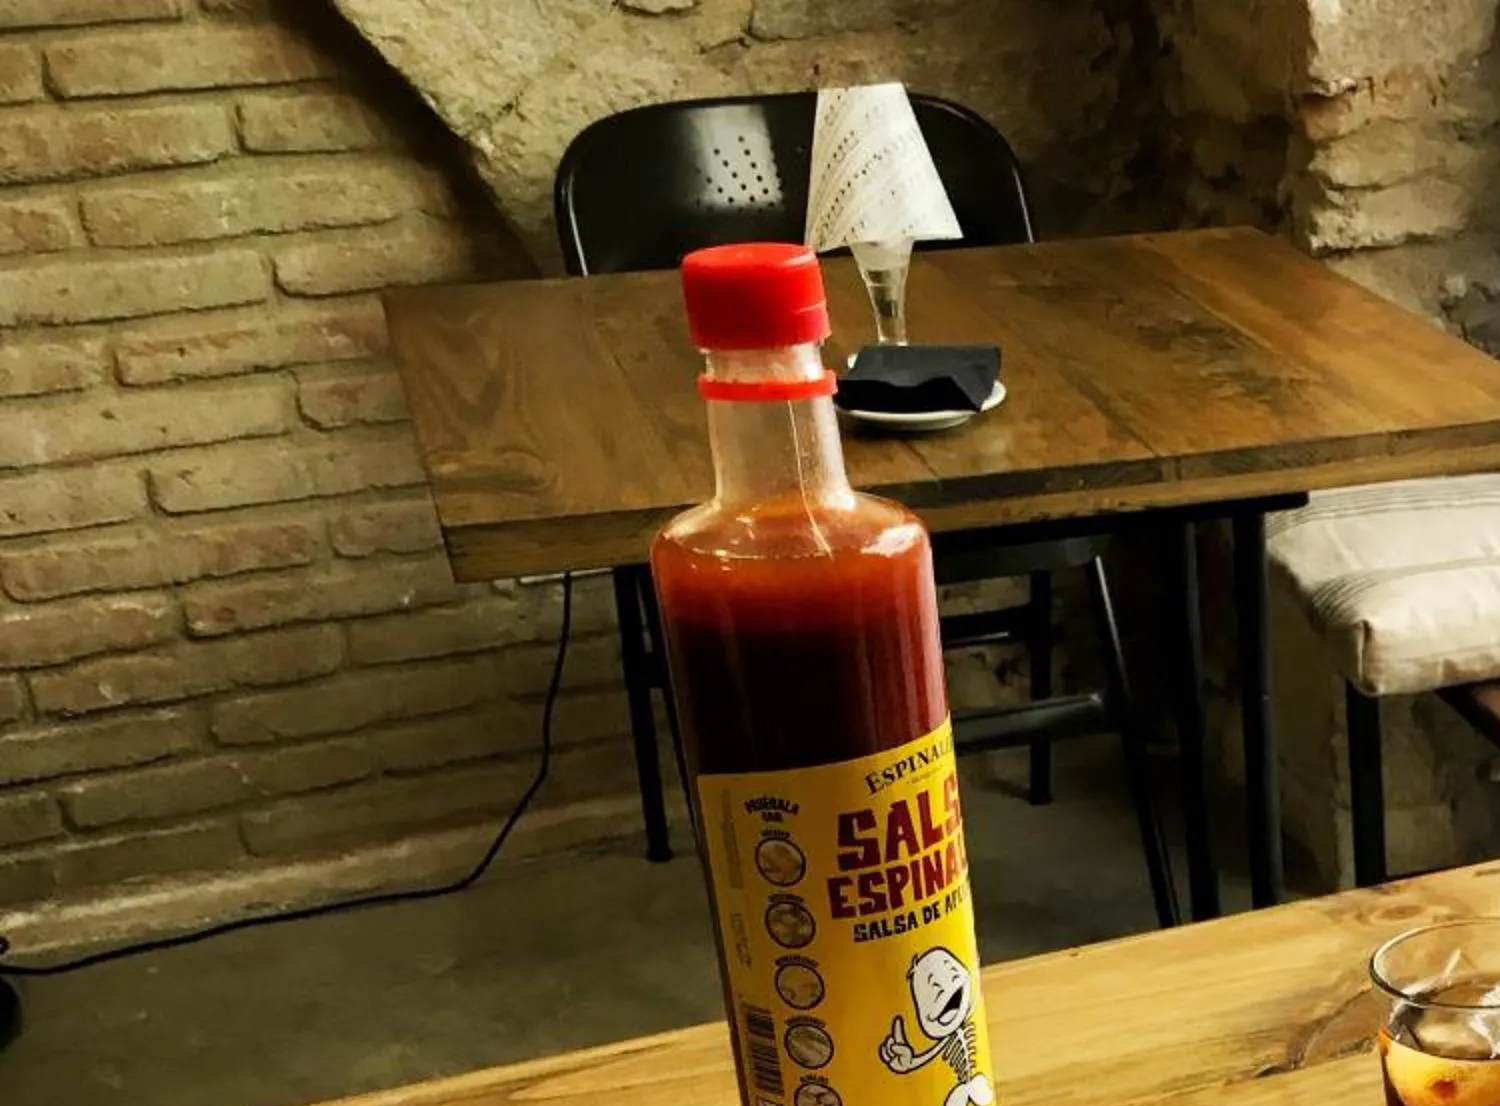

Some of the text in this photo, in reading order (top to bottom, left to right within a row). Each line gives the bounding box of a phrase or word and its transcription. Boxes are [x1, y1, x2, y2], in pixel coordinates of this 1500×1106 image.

[837, 772, 961, 871] SALS
[853, 910, 917, 943] SALSA
[922, 900, 941, 924] DE
